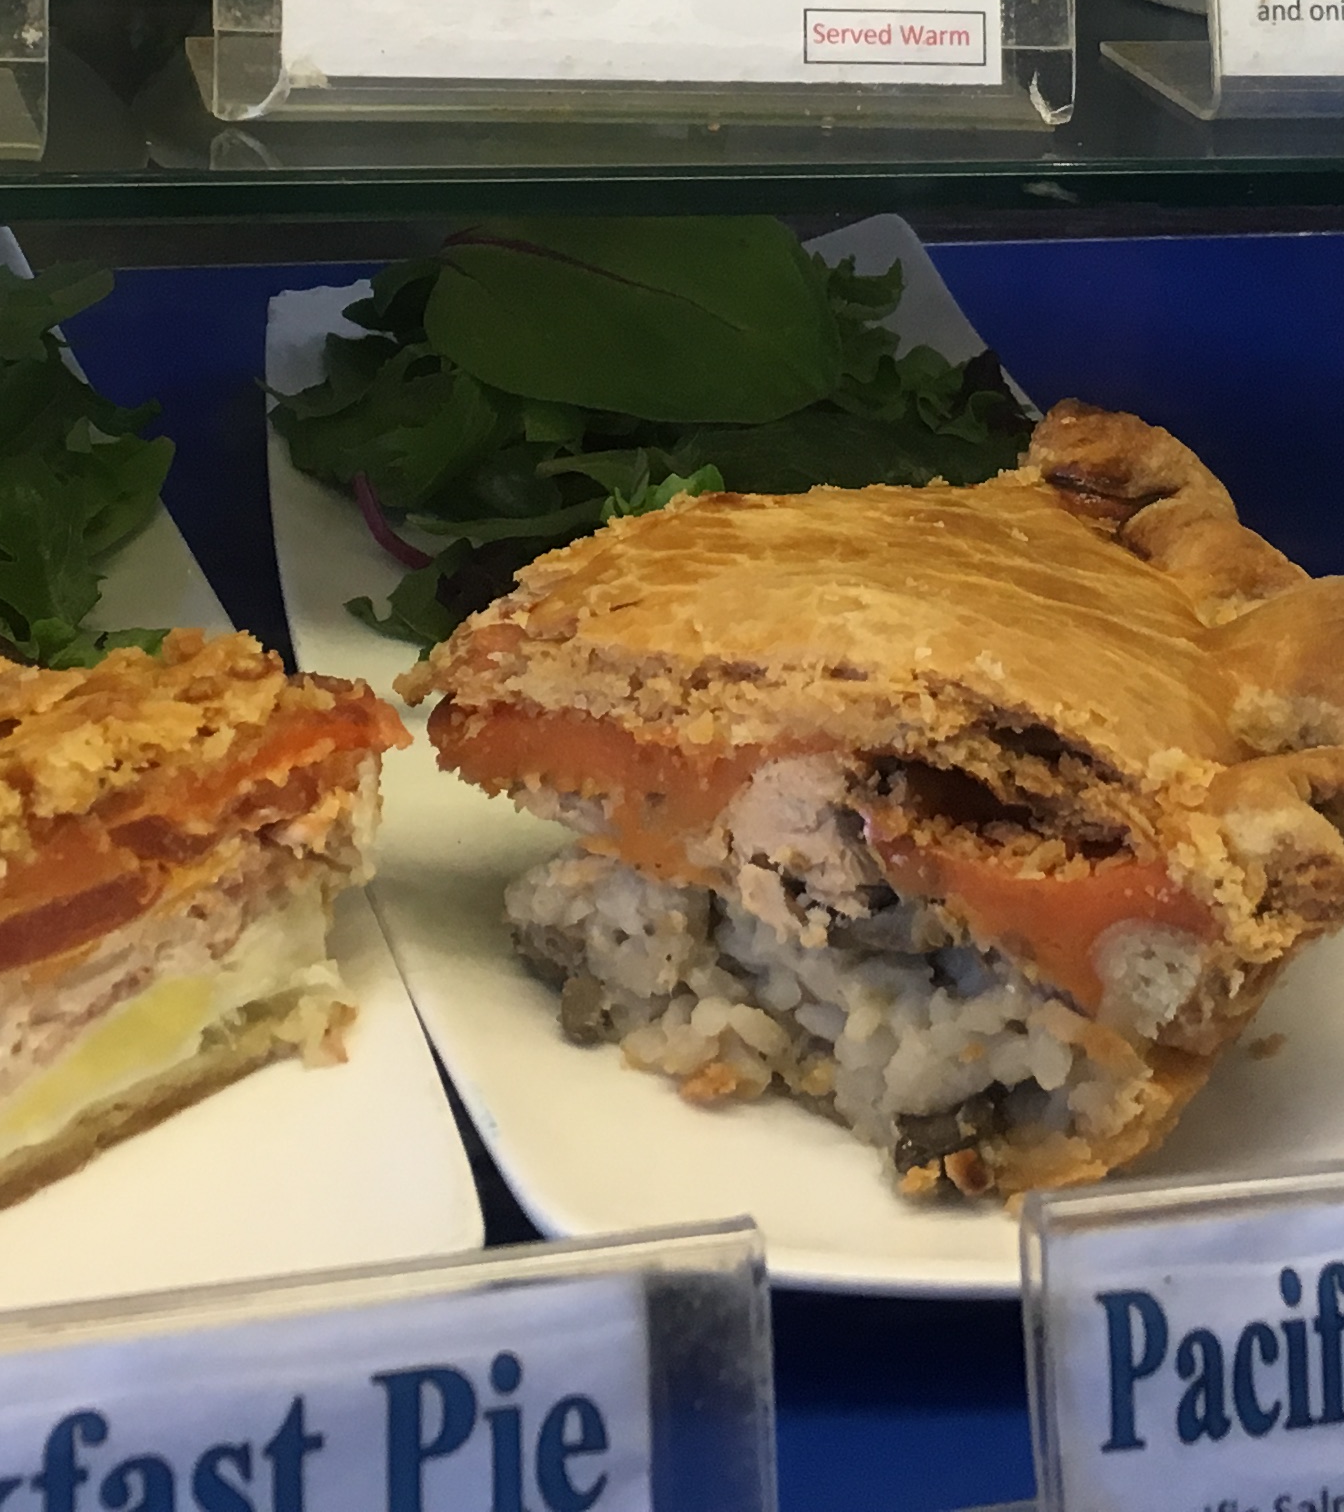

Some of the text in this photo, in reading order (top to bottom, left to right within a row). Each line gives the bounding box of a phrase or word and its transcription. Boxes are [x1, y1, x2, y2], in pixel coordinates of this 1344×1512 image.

[811, 23, 971, 47] Served Warm
[371, 1349, 609, 1512] Pie
